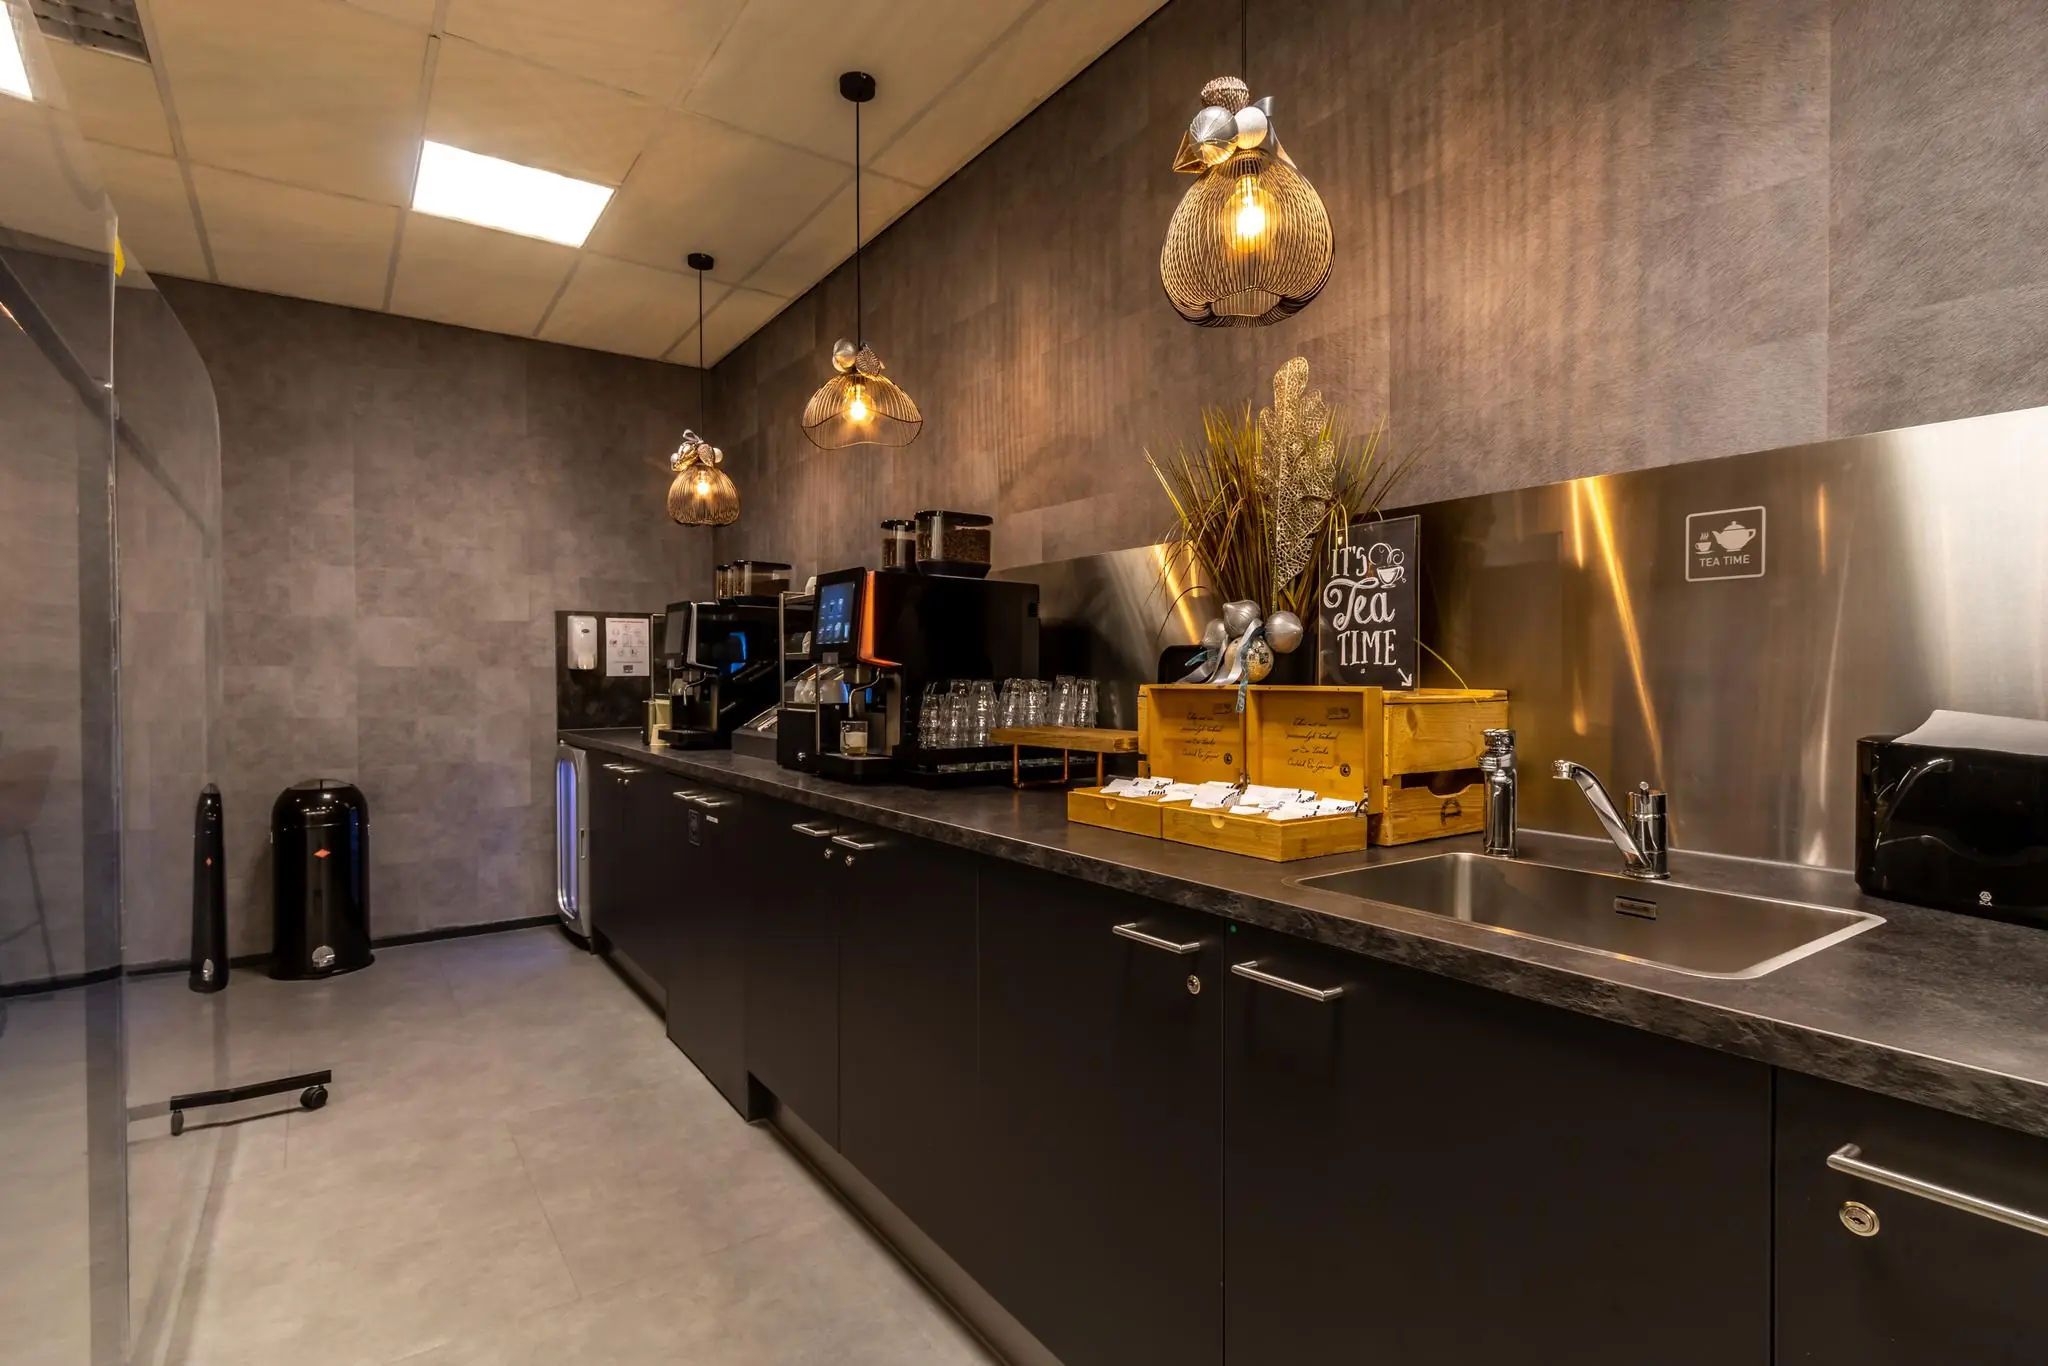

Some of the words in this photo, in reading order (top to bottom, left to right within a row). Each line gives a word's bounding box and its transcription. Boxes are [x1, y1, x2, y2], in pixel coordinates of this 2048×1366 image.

[1331, 546, 1368, 578] IT'S
[1699, 557, 1720, 567] TEA
[1723, 554, 1750, 565] TIME
[1323, 577, 1396, 631] Tea
[1337, 629, 1397, 666] TIME
